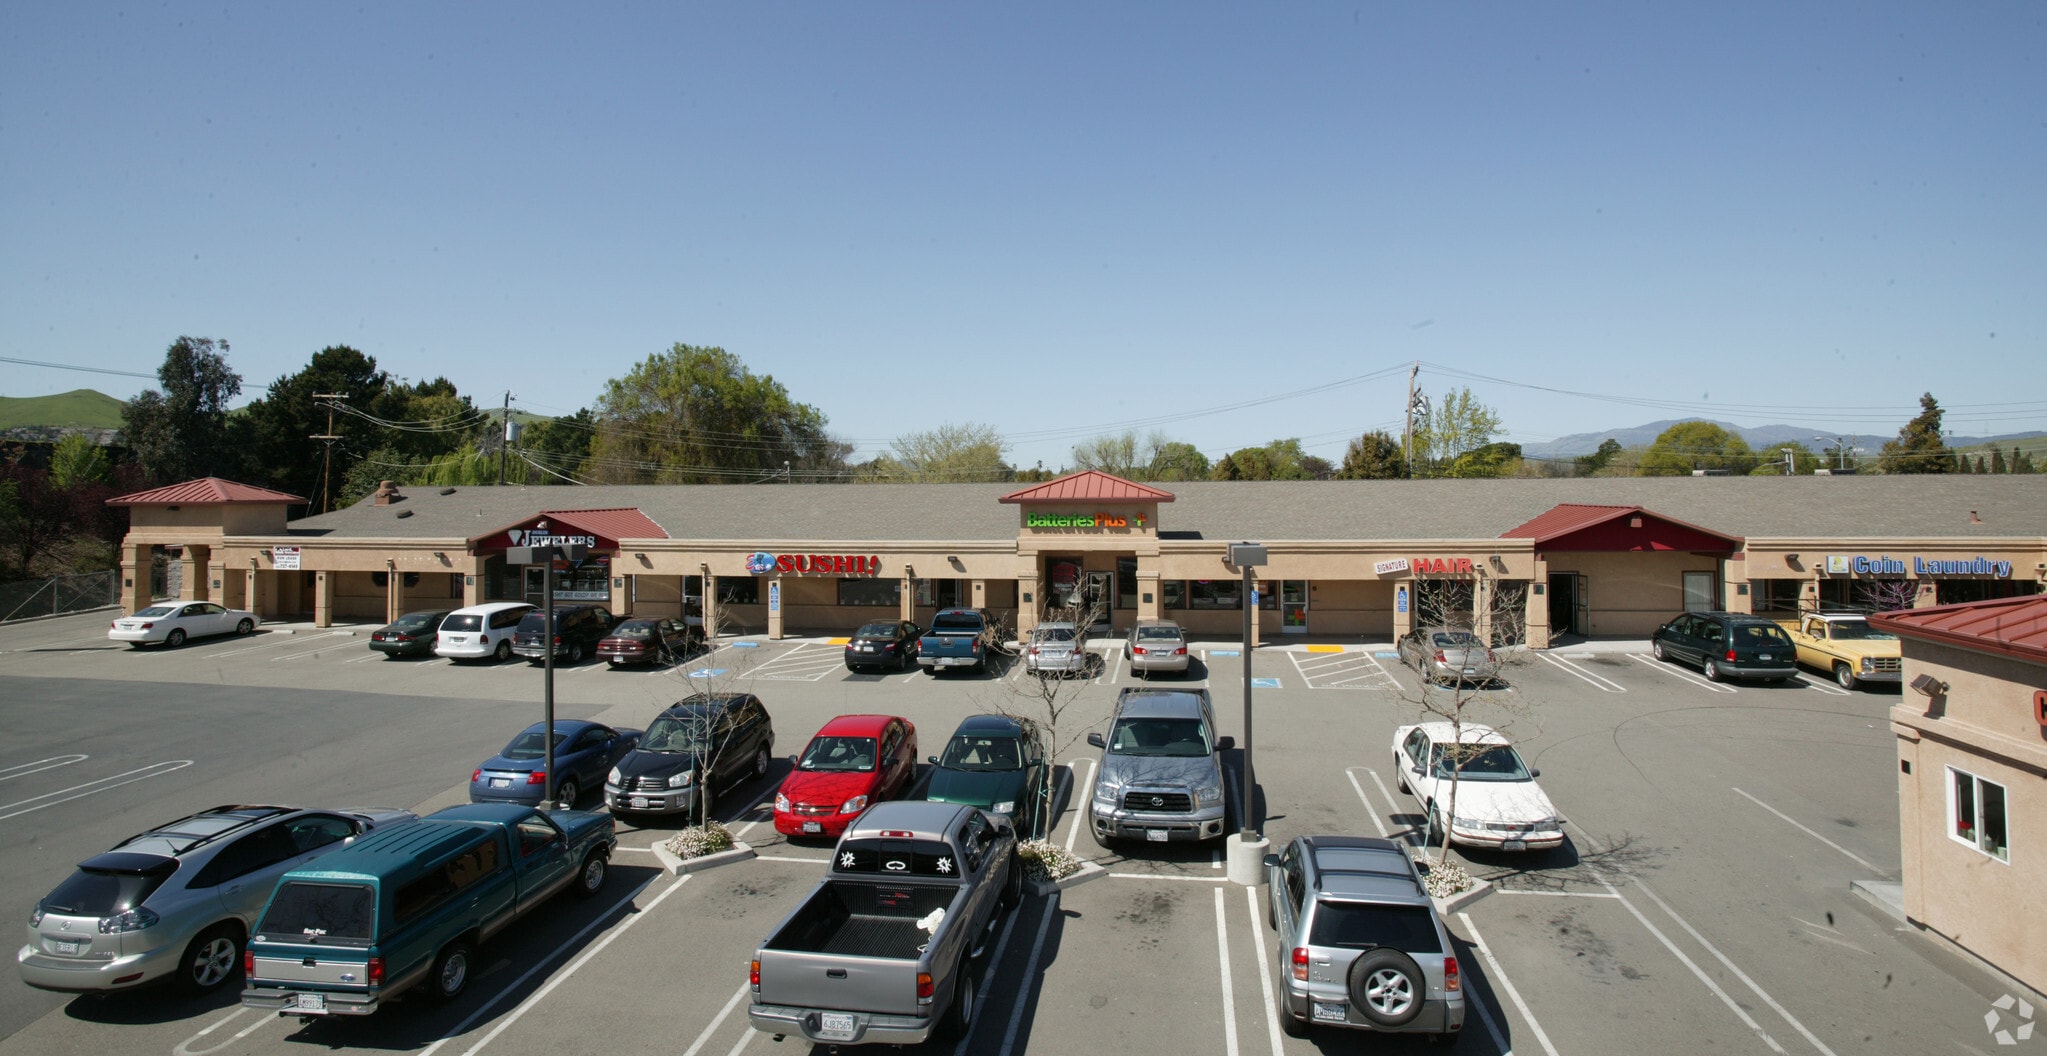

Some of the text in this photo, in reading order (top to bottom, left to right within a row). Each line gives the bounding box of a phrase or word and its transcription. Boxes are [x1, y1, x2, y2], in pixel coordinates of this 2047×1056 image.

[521, 530, 595, 548] JEWELERS
[776, 554, 879, 575] SUSHI!
[1377, 560, 1406, 573] SIGNATURE
[1413, 558, 1472, 574] HAIR
[1853, 555, 2013, 577] Coin Laundry
